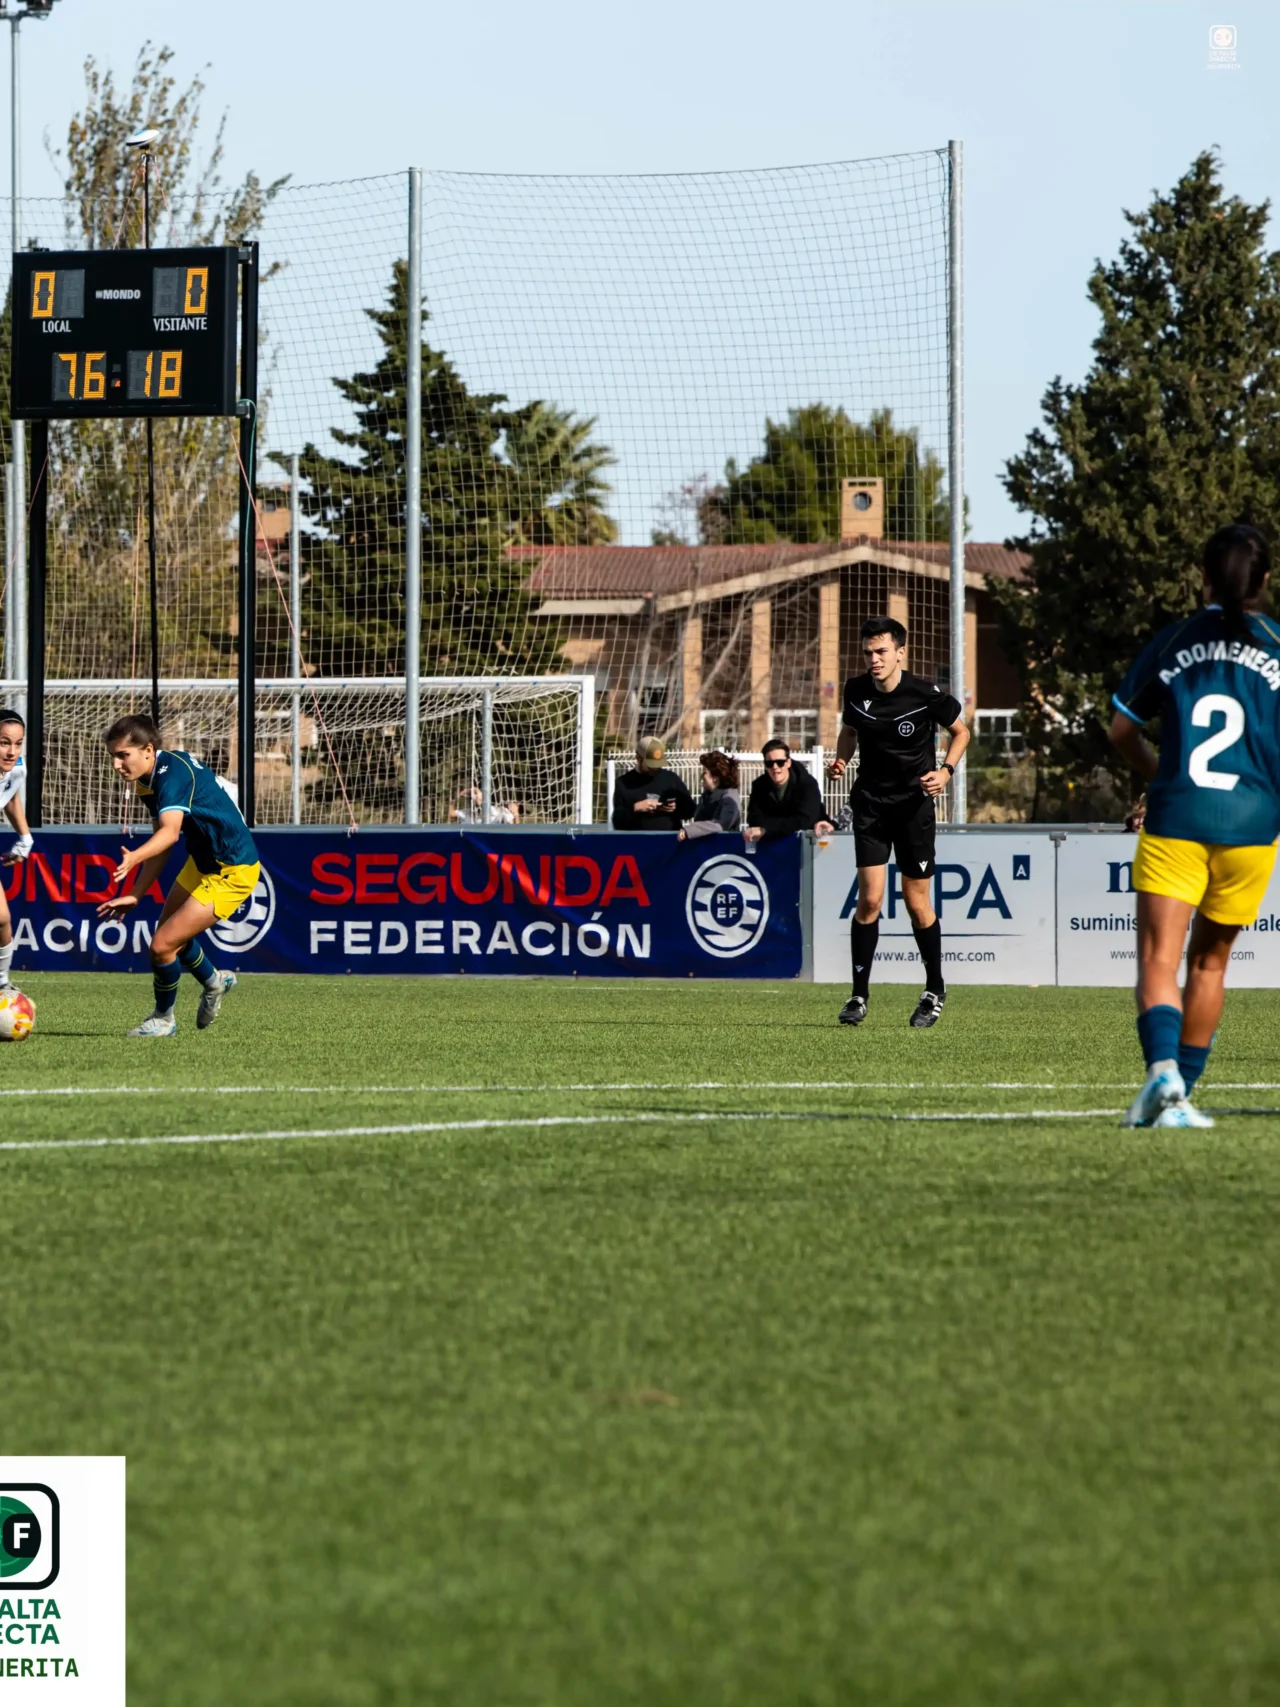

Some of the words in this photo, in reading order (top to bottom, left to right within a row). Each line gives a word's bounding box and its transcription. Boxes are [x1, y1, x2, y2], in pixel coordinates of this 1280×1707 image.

[42, 320, 71, 333] LOCAL
[153, 317, 208, 331] VISITANTE
[1188, 693, 1245, 791] 2
[309, 852, 651, 907] SEGUNDA
[310, 911, 651, 958] FEDERACIÓN
